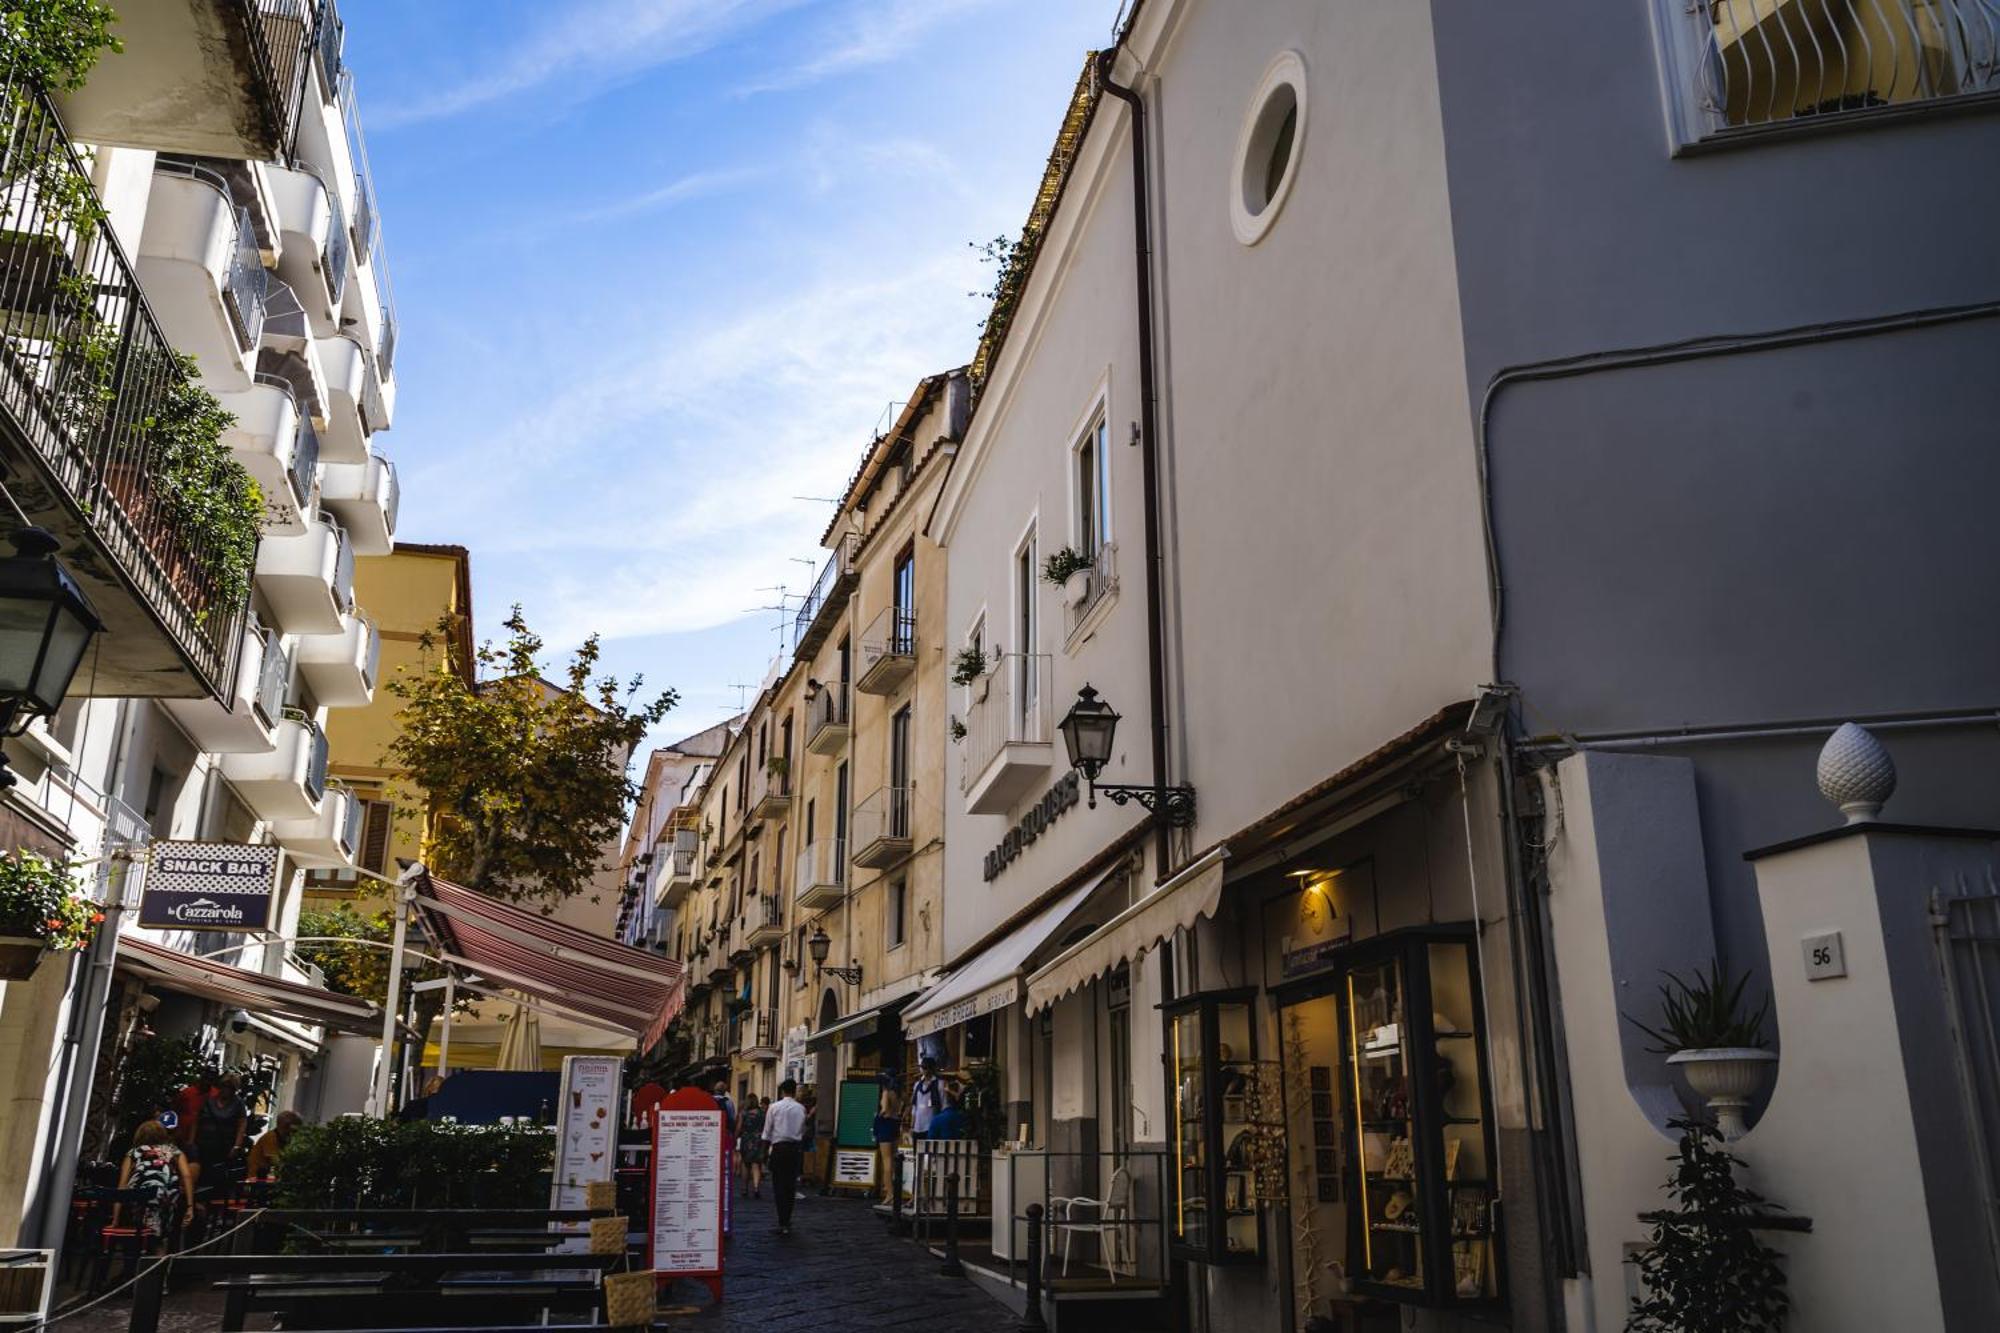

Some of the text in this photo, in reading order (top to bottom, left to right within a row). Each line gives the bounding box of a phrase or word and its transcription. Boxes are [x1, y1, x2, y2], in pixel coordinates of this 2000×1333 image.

[162, 859, 262, 875] SNACK BAR
[175, 904, 243, 920] Cazzarola
[1813, 946, 1831, 966] 56
